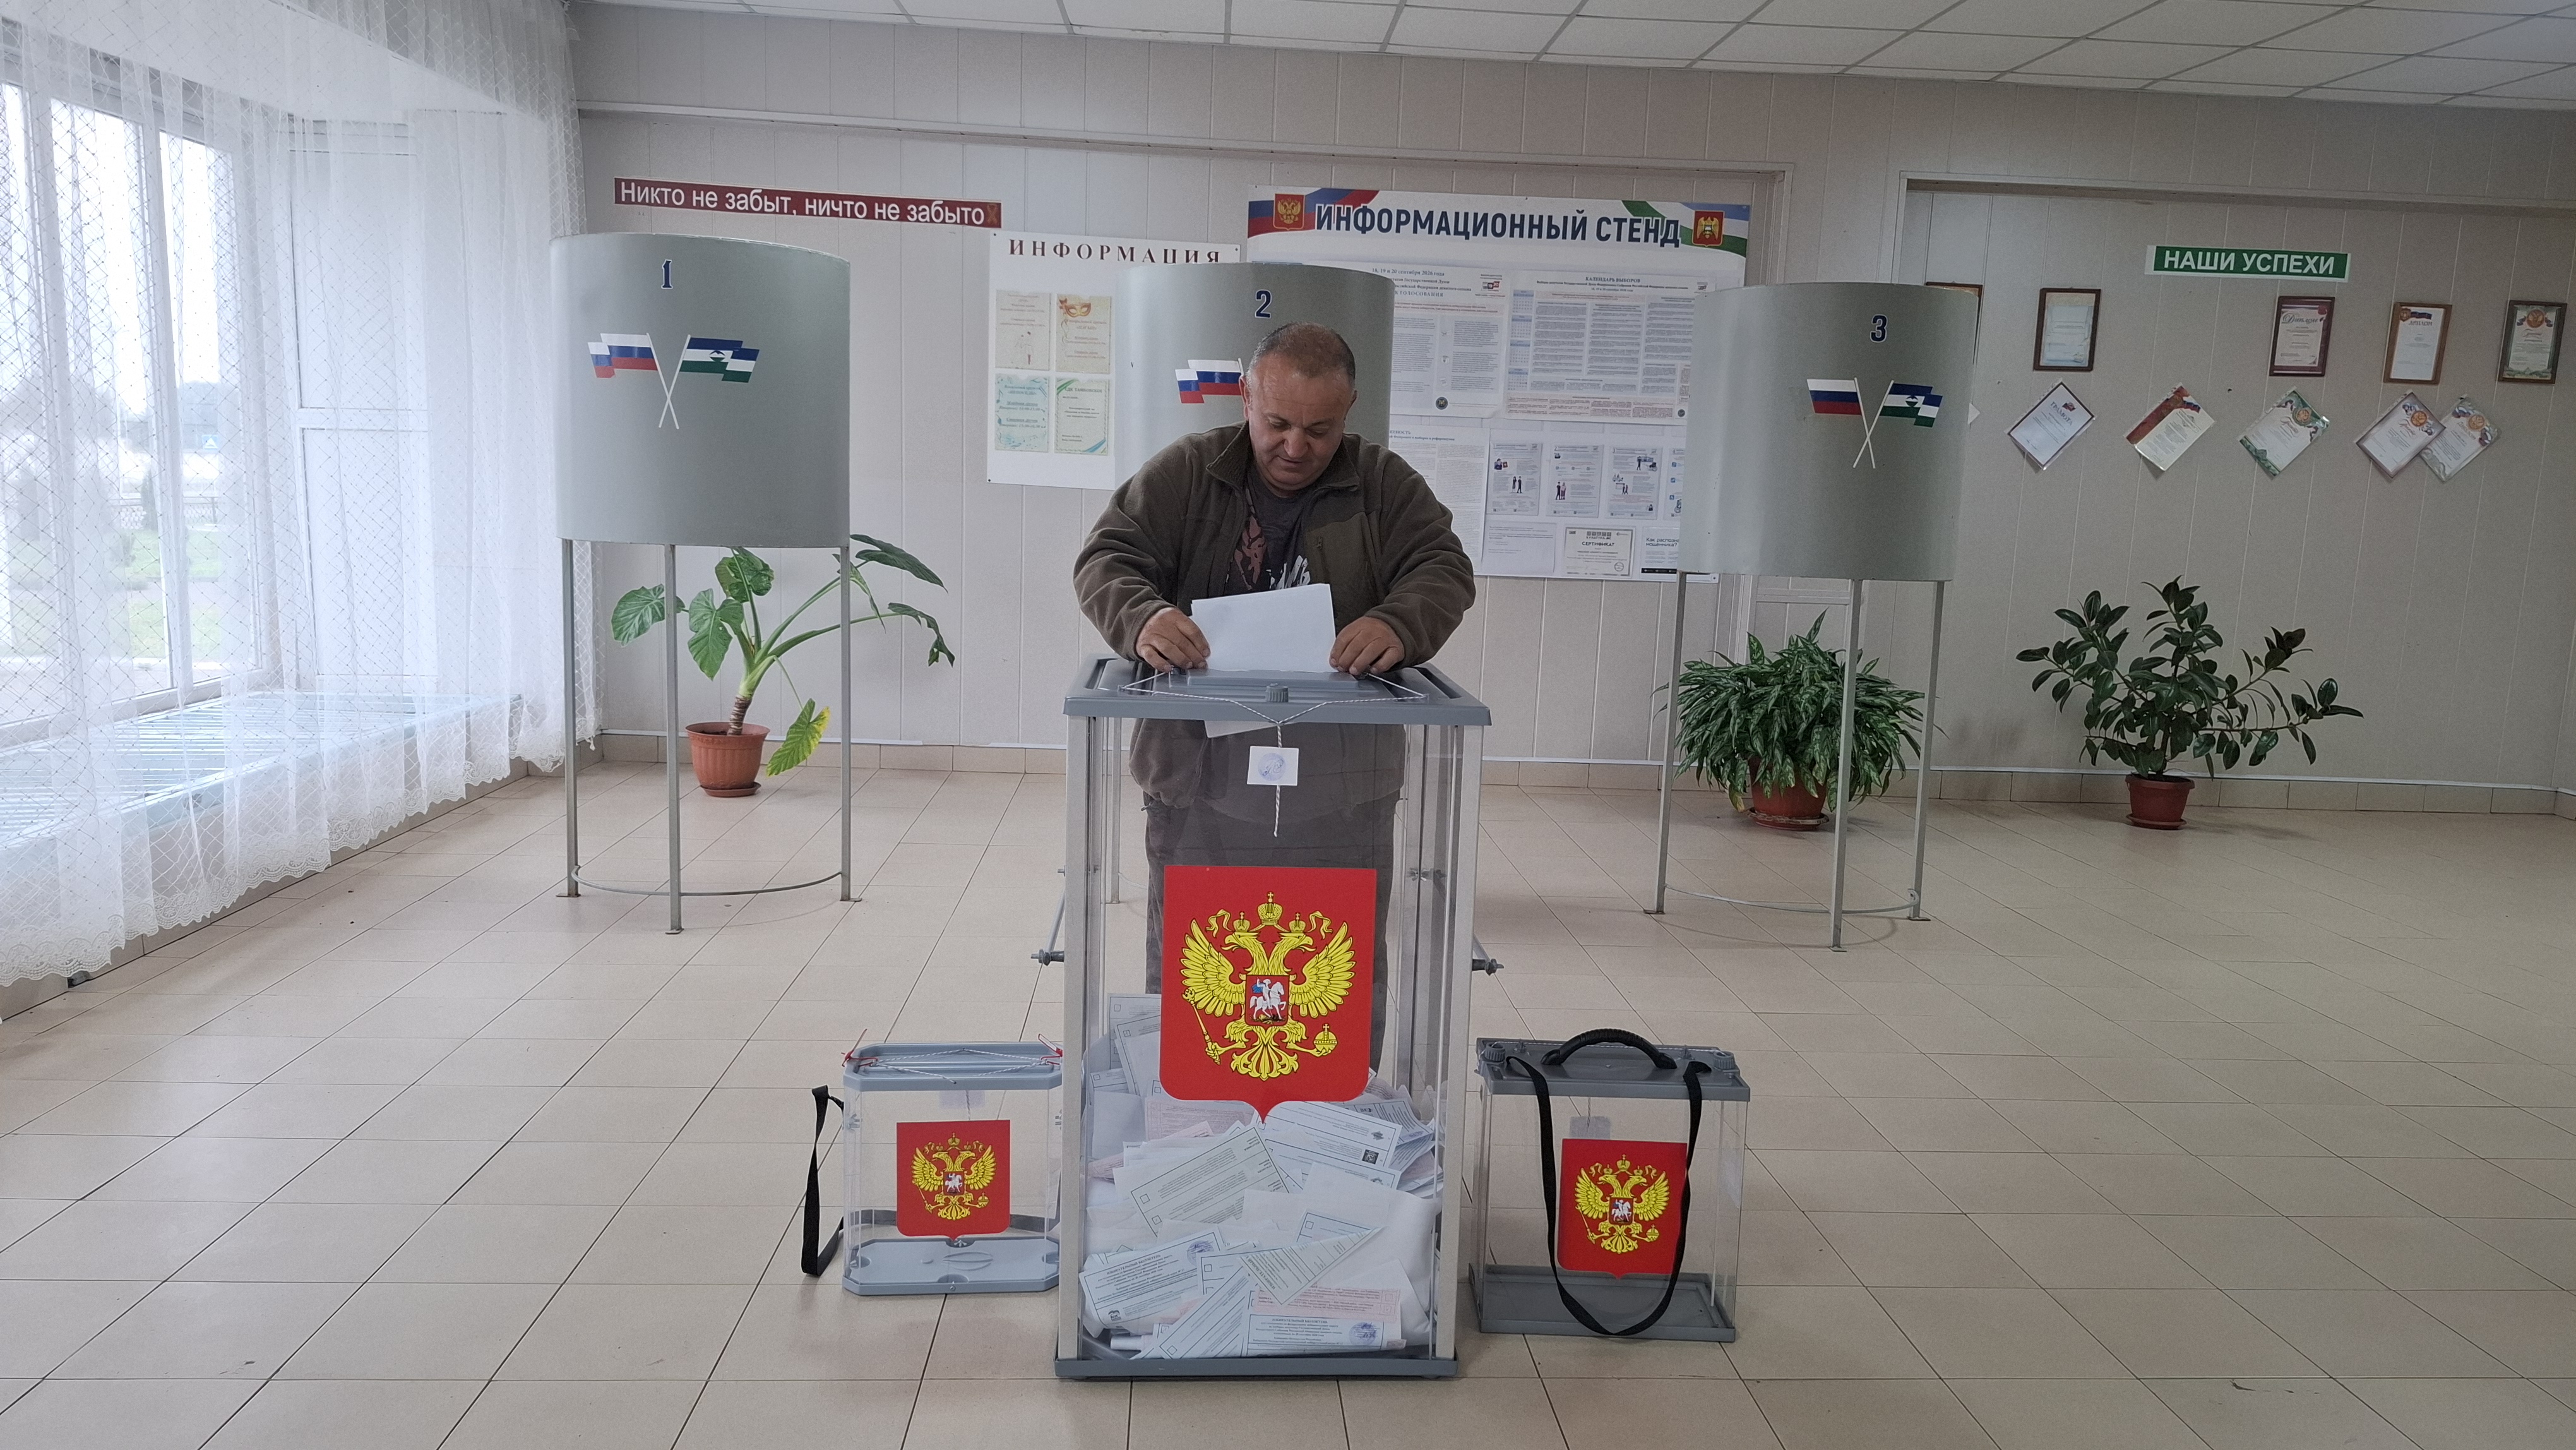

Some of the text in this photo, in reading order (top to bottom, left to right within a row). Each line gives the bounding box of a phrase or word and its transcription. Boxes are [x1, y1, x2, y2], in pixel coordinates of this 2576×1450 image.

[621, 181, 985, 225] Никто не забыт, ничто не забыто
[1316, 204, 1681, 248] ИНФОРМАЦИОННЫЙ СТЕНД
[1009, 239, 1220, 263] ИНФОРМАЦИЯ
[2164, 250, 2335, 275] НАШИ УСПЕХИ
[662, 260, 673, 289] 1
[1255, 289, 1272, 318] 2
[1870, 314, 1888, 343] 3
